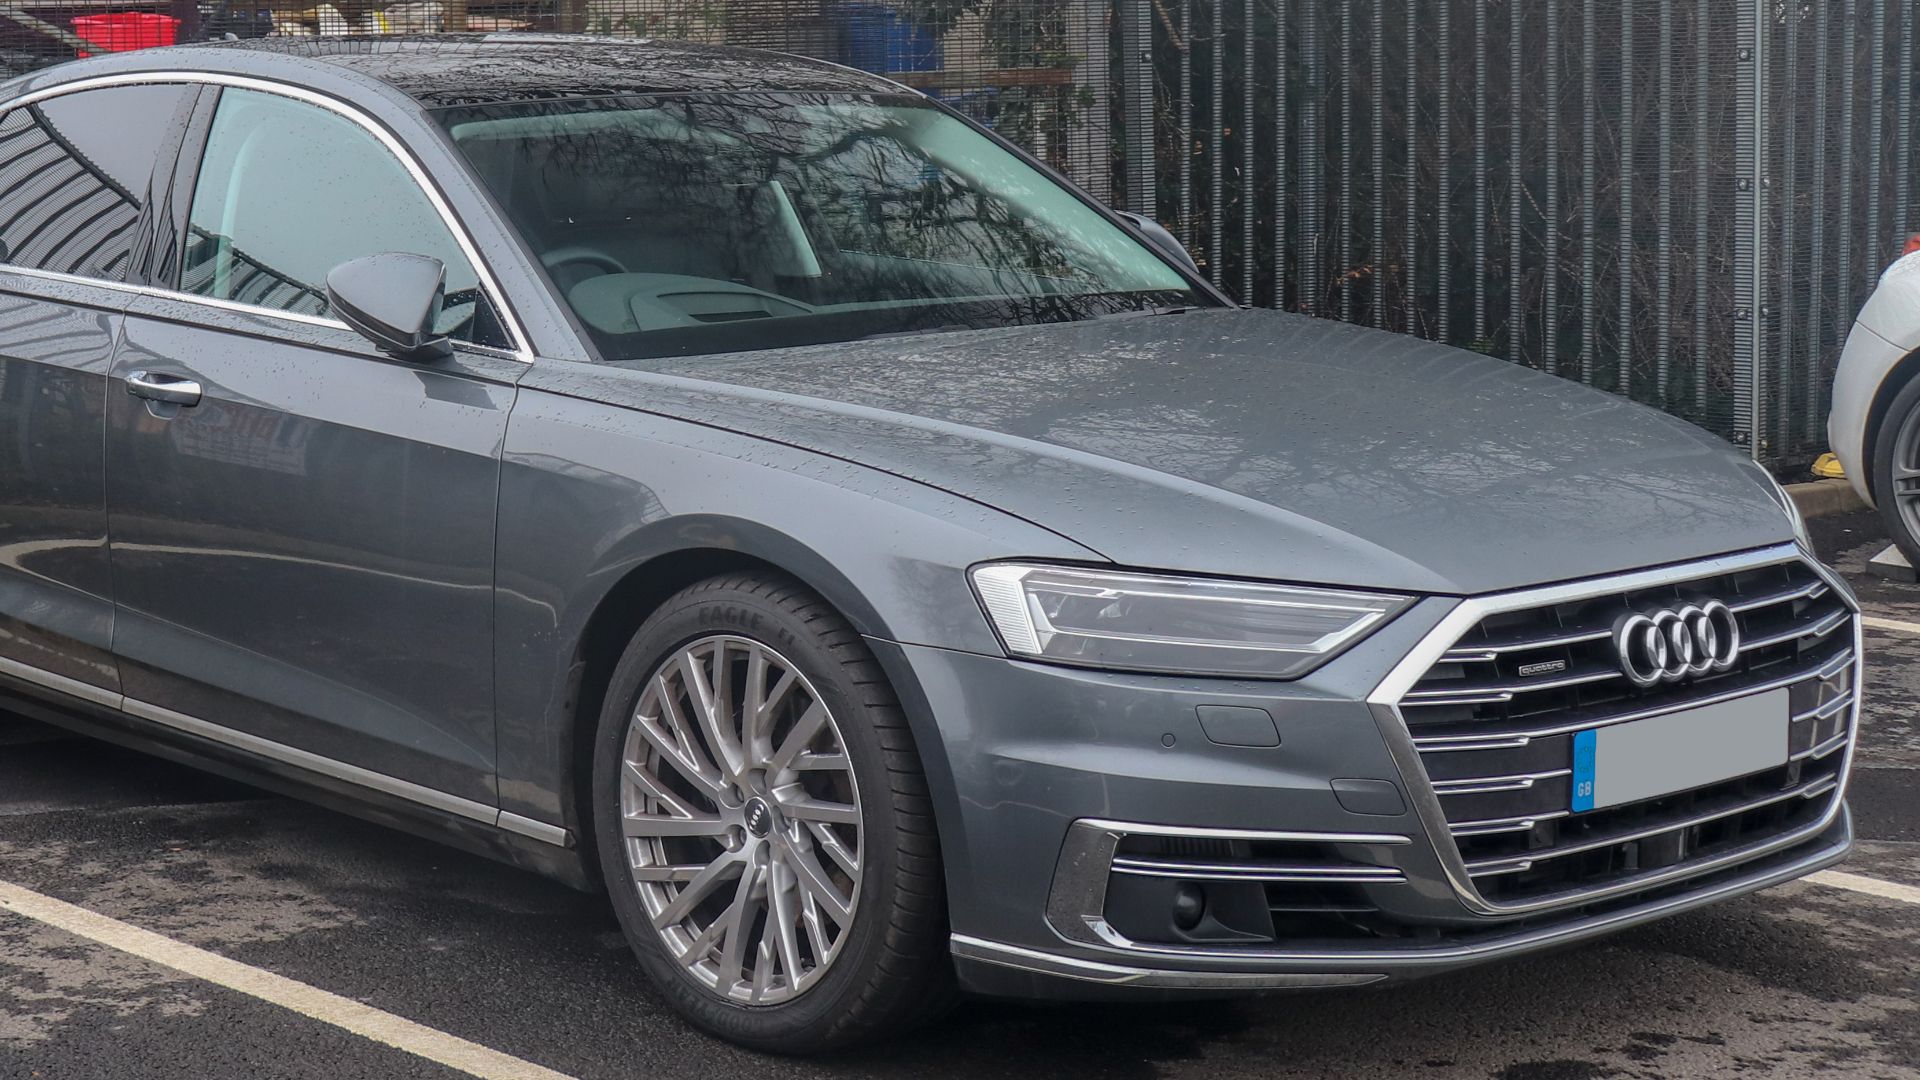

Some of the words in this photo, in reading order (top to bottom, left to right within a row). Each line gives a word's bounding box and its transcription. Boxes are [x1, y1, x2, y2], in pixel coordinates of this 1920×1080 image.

[698, 605, 763, 629] EAGLE
[1521, 662, 1564, 674] quattro
[1577, 781, 1592, 797] GB
